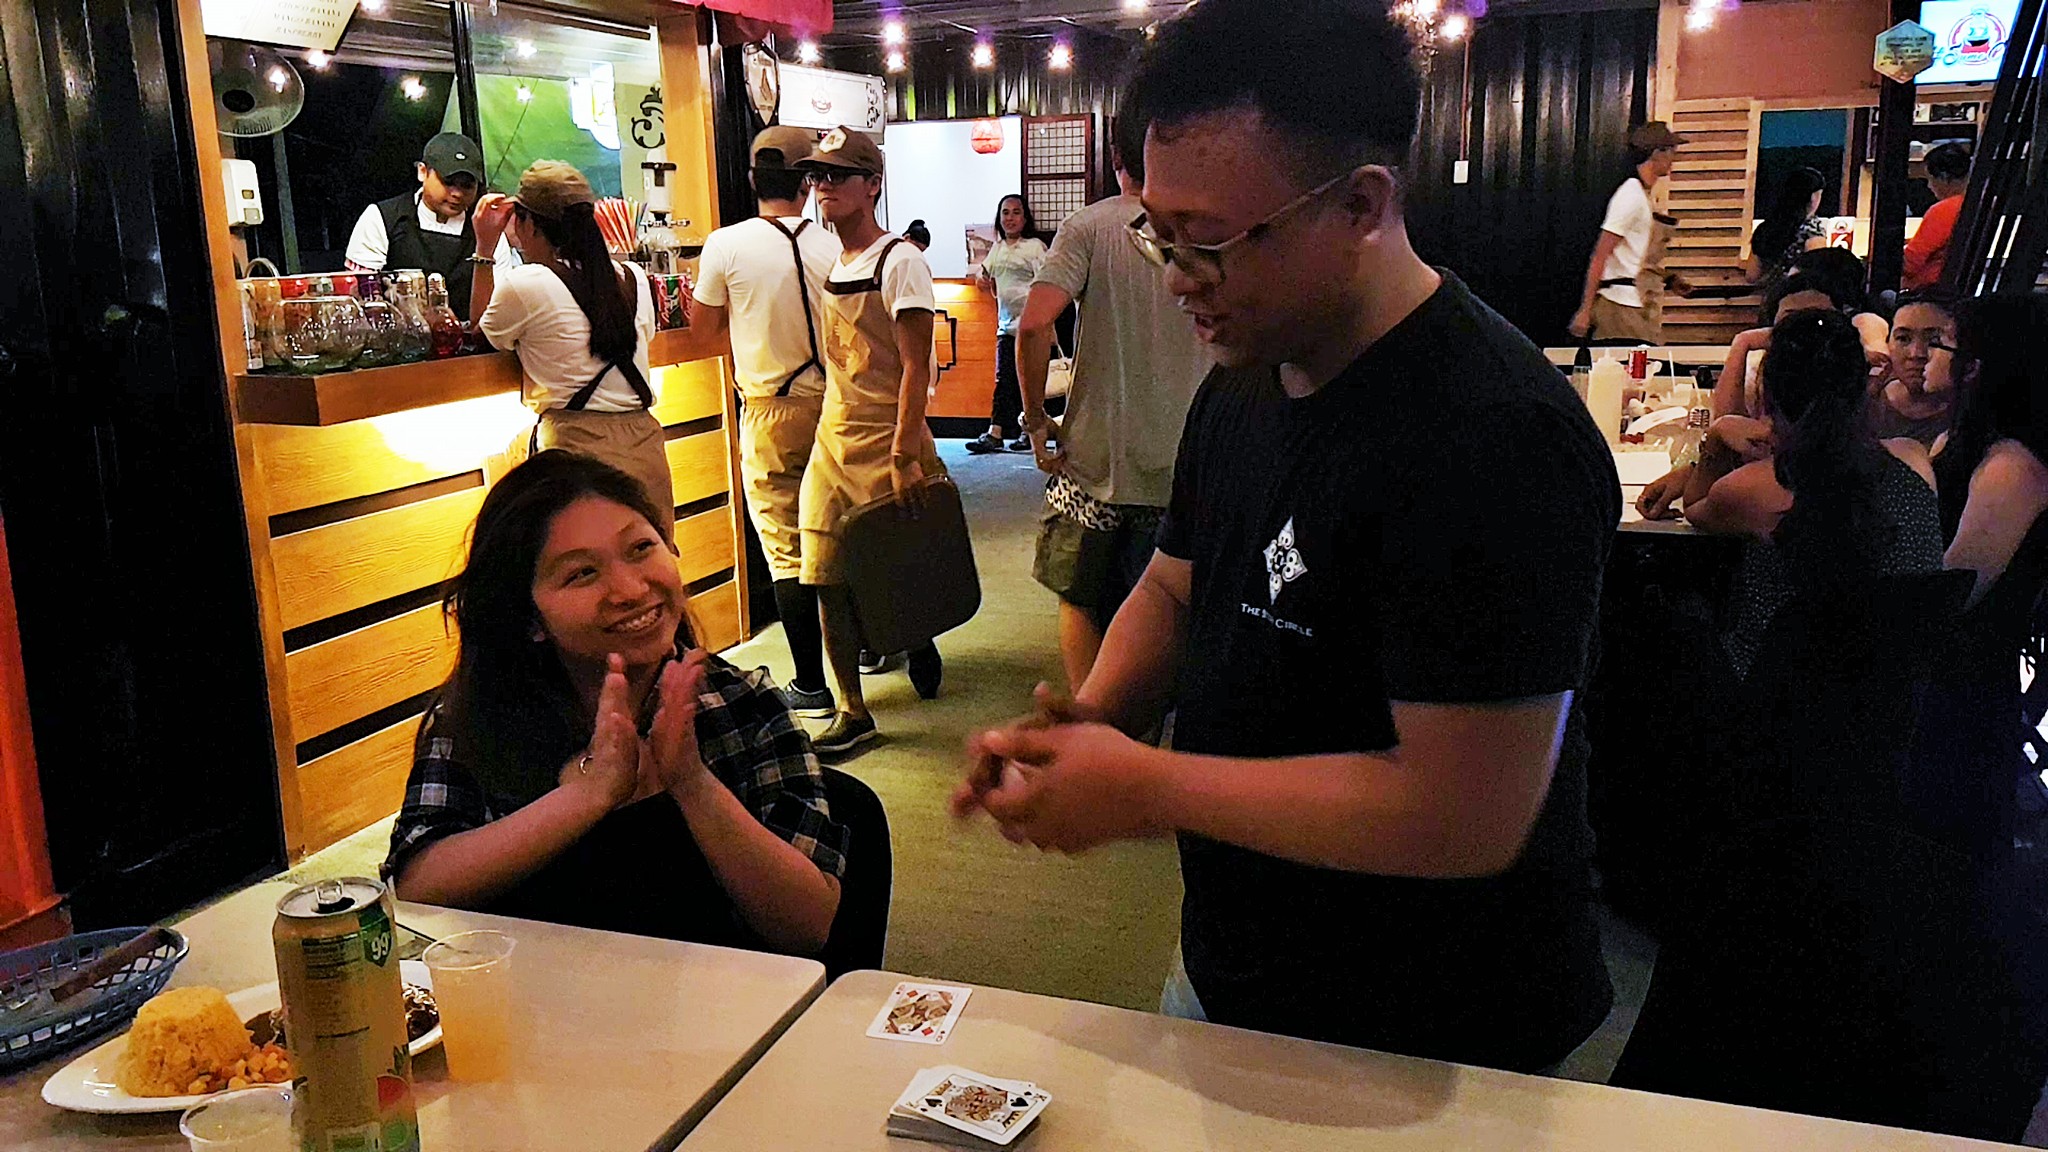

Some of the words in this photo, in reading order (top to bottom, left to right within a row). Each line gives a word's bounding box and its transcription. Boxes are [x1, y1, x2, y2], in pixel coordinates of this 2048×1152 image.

[310, 6, 341, 17] BANANA
[274, 12, 304, 22] MANGO
[305, 18, 335, 29] BANANA
[1241, 603, 1261, 617] THE
